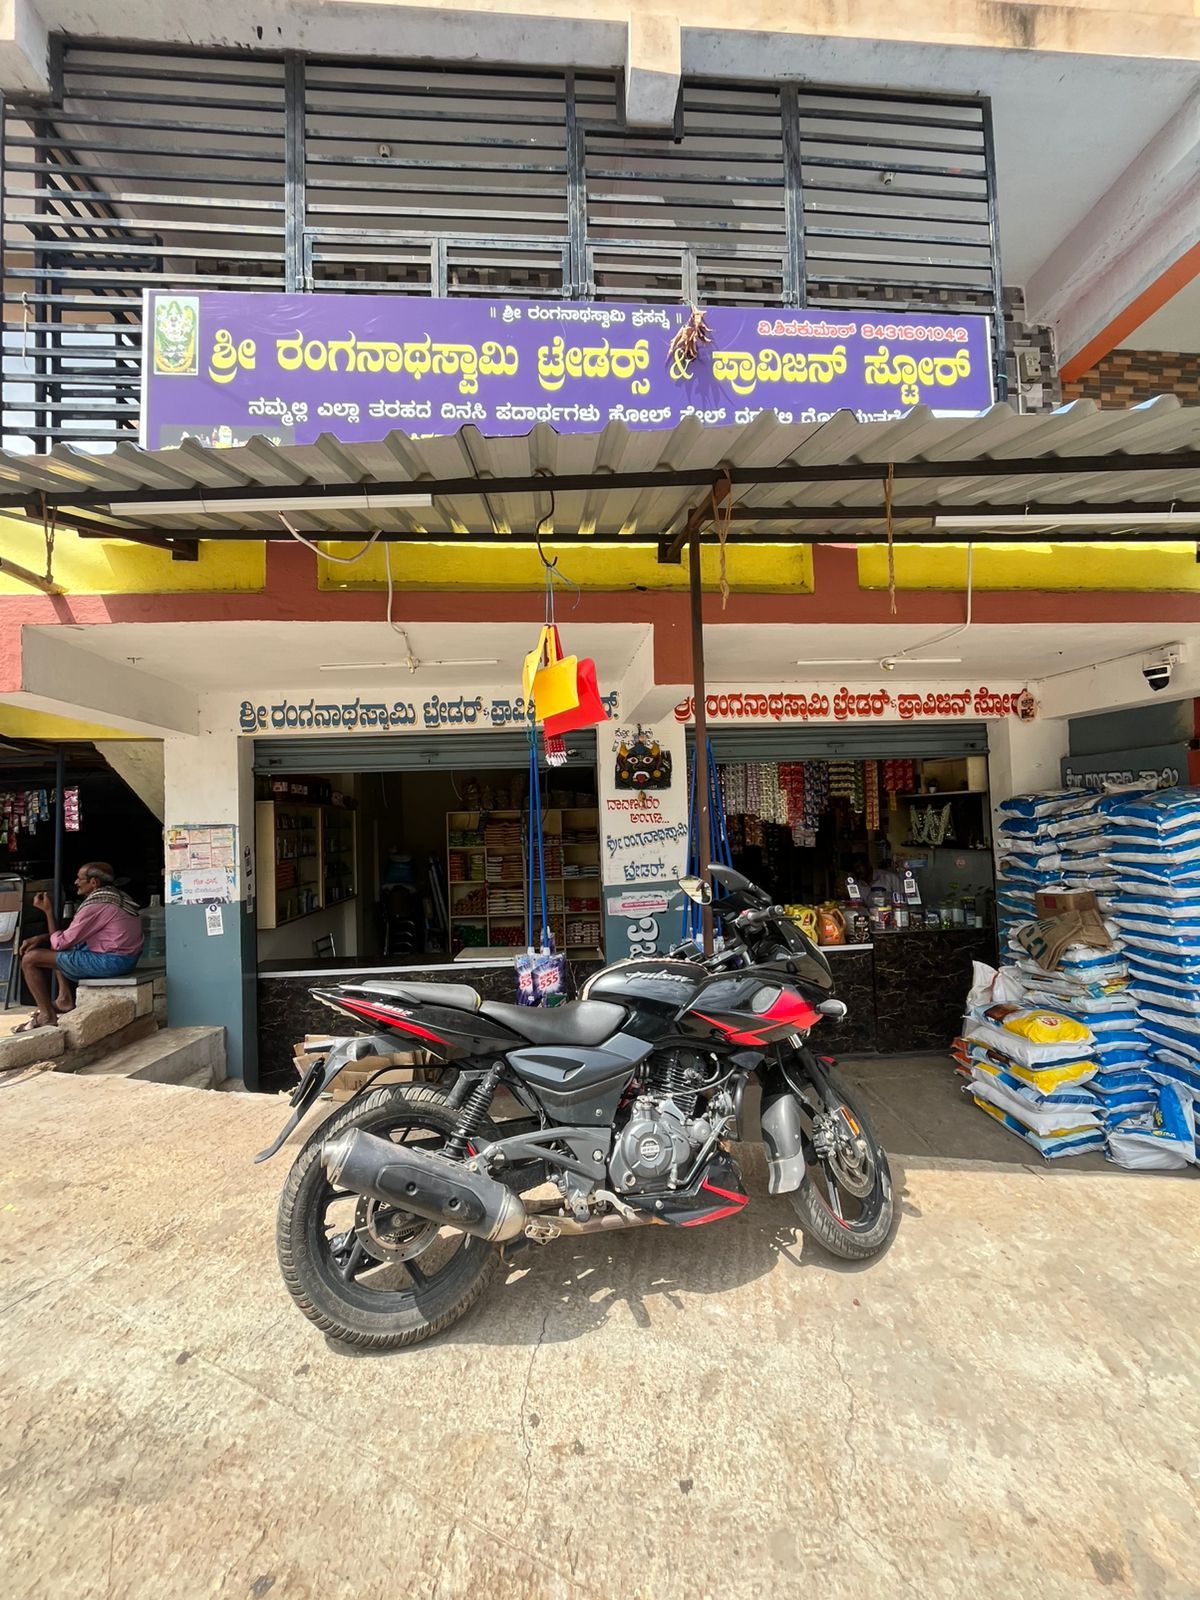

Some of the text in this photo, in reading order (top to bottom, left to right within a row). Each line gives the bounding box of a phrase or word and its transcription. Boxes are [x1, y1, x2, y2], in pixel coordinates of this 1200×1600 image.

[502, 304, 522, 323] ಶ್ರೀ
[527, 305, 626, 328] ರಂಗನಾಥಸ್ವಾಮಿ
[631, 309, 671, 330] ಪ್ರಸನ್ನ
[757, 320, 969, 343] ವಿ.ಶಿವಕುಮಾರ್ 8431601042
[208, 328, 972, 406] ಶ್ರೀ ರಂಗನಾಥಸ್ವಾಮಿ ಟ್ರೇಡರ್ಸ್ & ಪ್ರಾವಿಜನ್ ಸ್ಟೋರ್
[248, 396, 309, 426] ನಮ್ಮಲ್ಲಿ
[316, 399, 360, 424] ಎಲ್ಲಾ
[368, 399, 432, 419] ತರಹದ
[440, 400, 488, 420] ದಿನಸಿ
[495, 402, 601, 423] ಪದಾರ್ಥಗಳು
